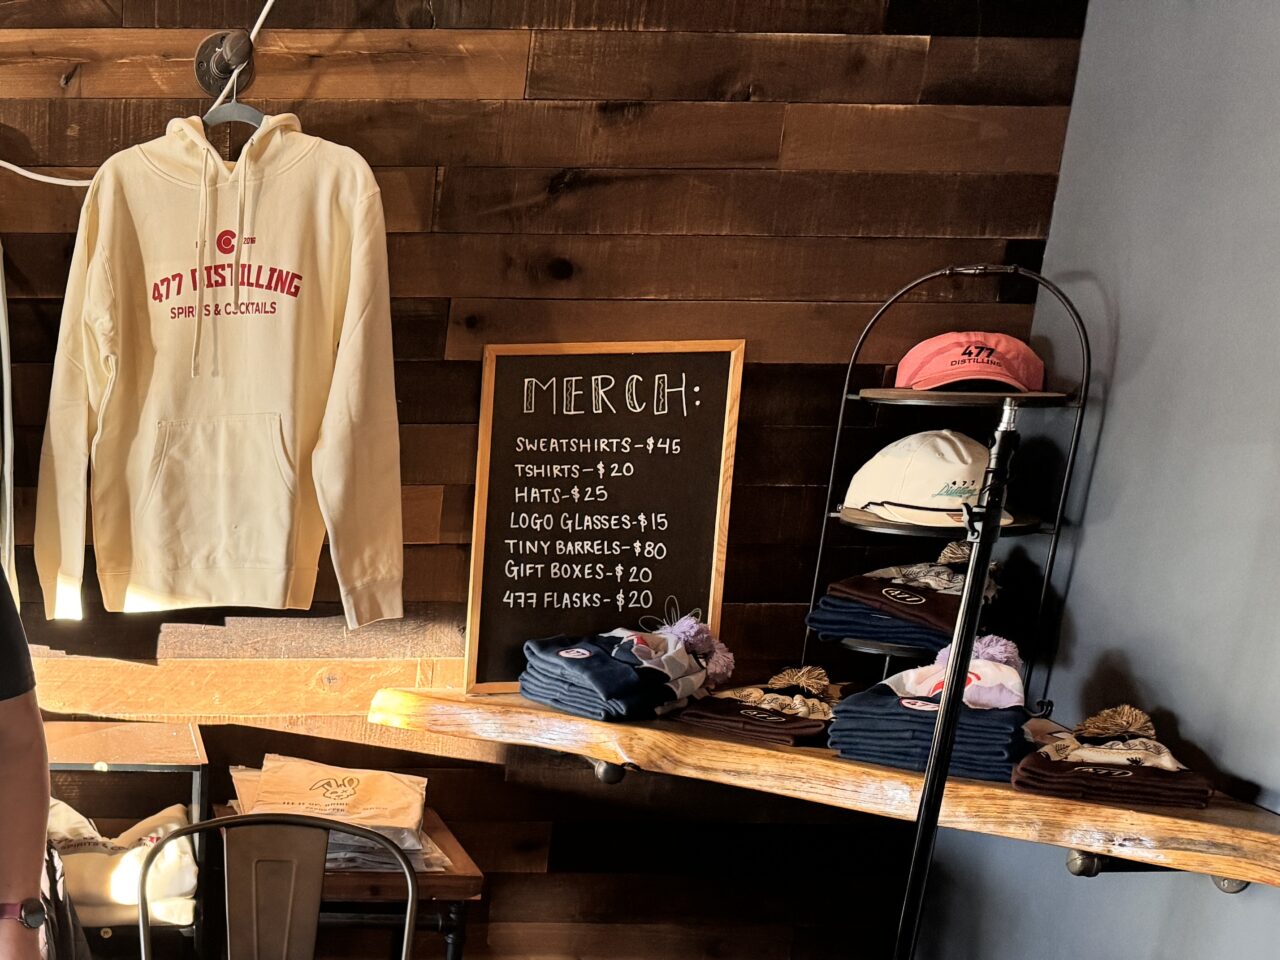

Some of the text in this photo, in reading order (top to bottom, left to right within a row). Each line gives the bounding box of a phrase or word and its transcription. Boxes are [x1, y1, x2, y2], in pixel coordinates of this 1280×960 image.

[152, 272, 183, 303] 477
[170, 304, 211, 319] SPIRS
[214, 303, 221, 316] &
[961, 345, 995, 359] 477
[950, 357, 1003, 368] DISTILLING
[523, 372, 701, 417] MERCH:
[510, 512, 554, 532] LOGO
[504, 539, 550, 555] TINY
[504, 559, 545, 580] GIFT
[502, 590, 537, 609] 477
